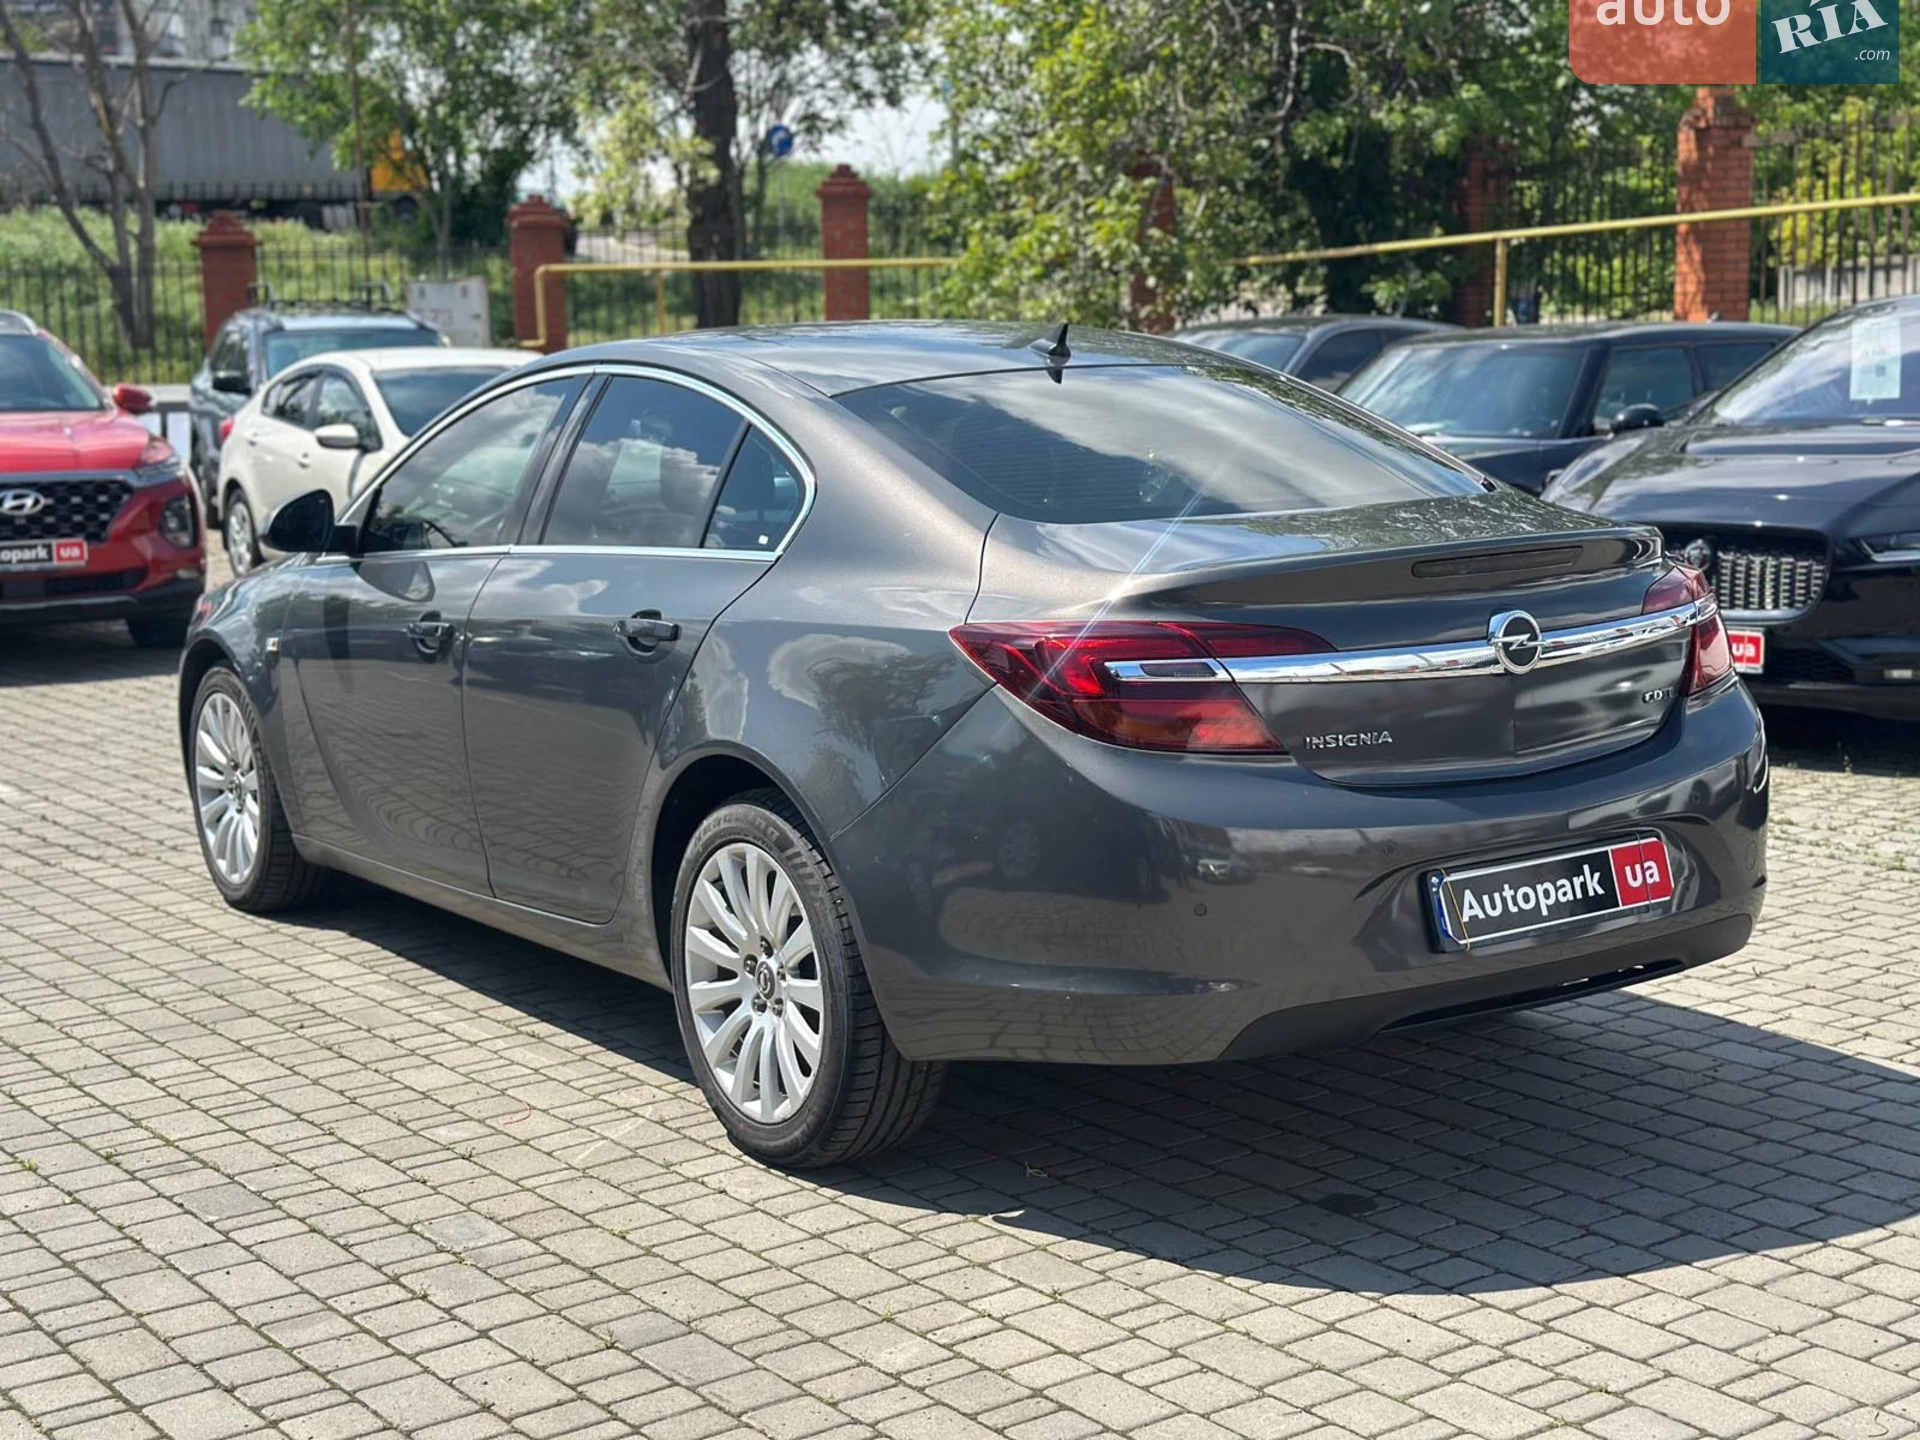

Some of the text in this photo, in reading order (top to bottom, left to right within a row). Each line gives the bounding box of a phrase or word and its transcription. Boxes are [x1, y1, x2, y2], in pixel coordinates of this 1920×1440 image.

[60, 547, 80, 558] ua
[1731, 642, 1756, 657] ua
[1305, 731, 1393, 749] INSIGNIA
[1462, 860, 1661, 922] Autopark ua
